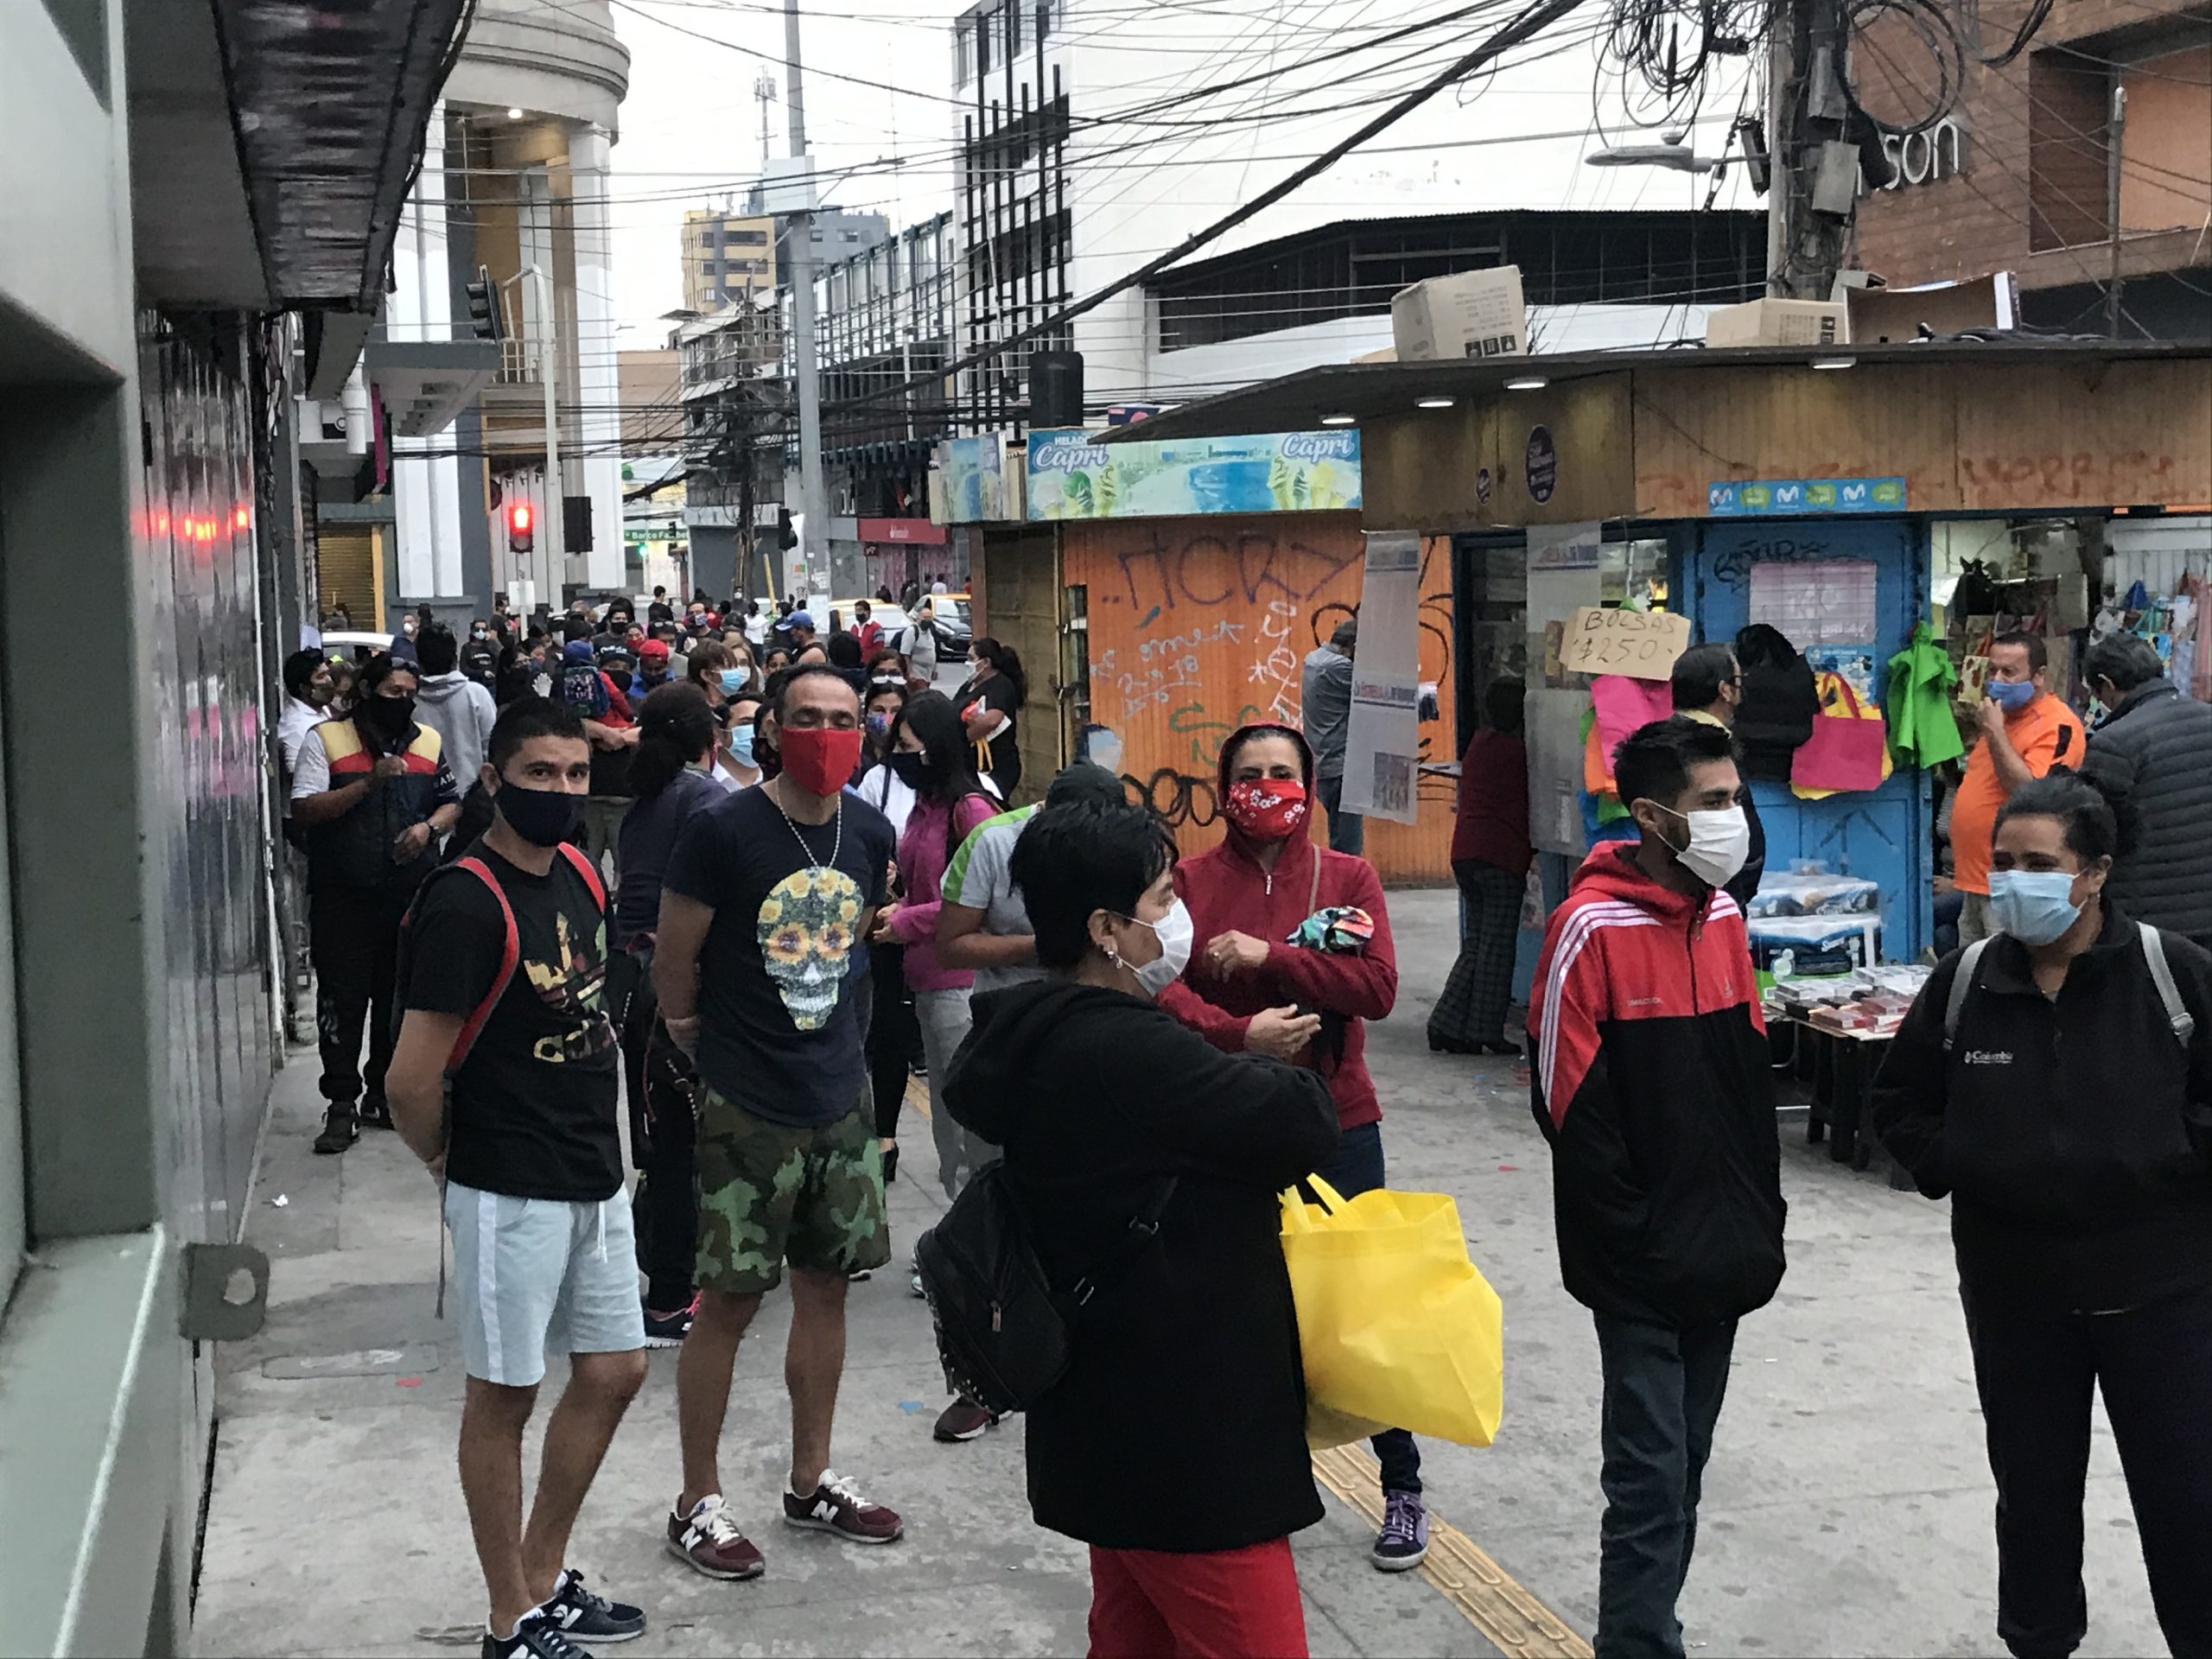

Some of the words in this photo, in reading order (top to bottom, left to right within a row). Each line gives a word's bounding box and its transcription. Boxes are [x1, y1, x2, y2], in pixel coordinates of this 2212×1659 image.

[1858, 116, 1959, 195] son
[1034, 442, 1109, 474] Capri
[1283, 430, 1355, 464] Capri
[1584, 610, 1678, 635] BOLSAS
